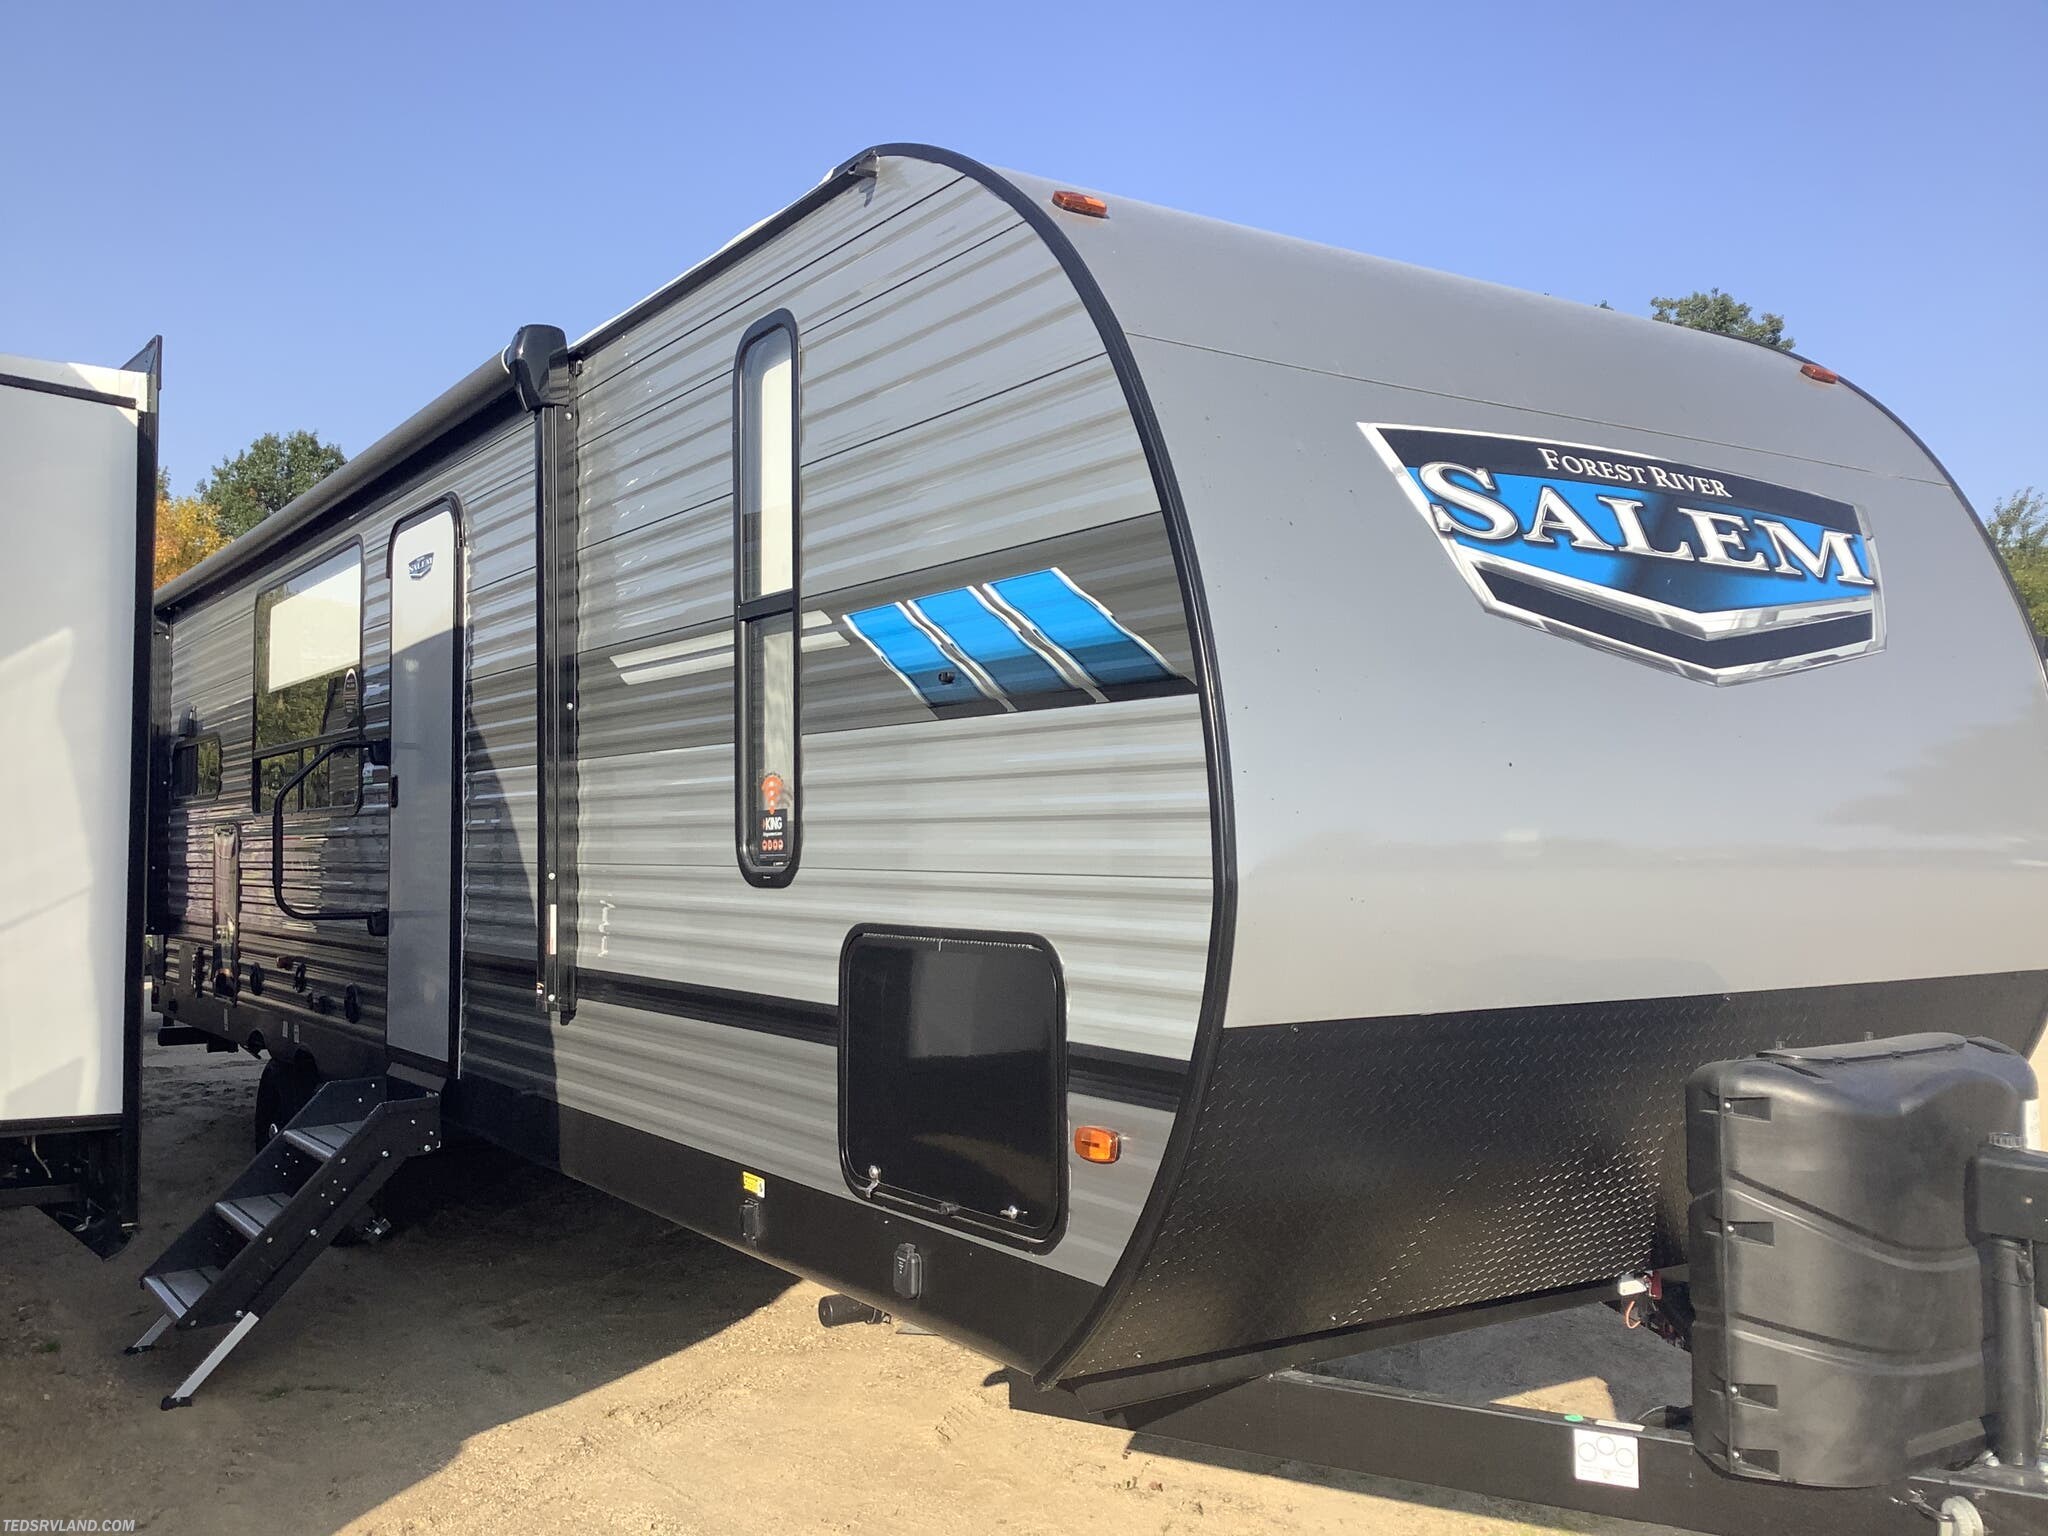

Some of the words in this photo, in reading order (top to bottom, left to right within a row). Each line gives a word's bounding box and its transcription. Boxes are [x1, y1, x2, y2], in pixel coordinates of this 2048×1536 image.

[1537, 447, 1647, 485] FOREST
[1647, 465, 1733, 498] RIVER
[1418, 460, 1876, 587] SALEM
[765, 816, 783, 831] KING
